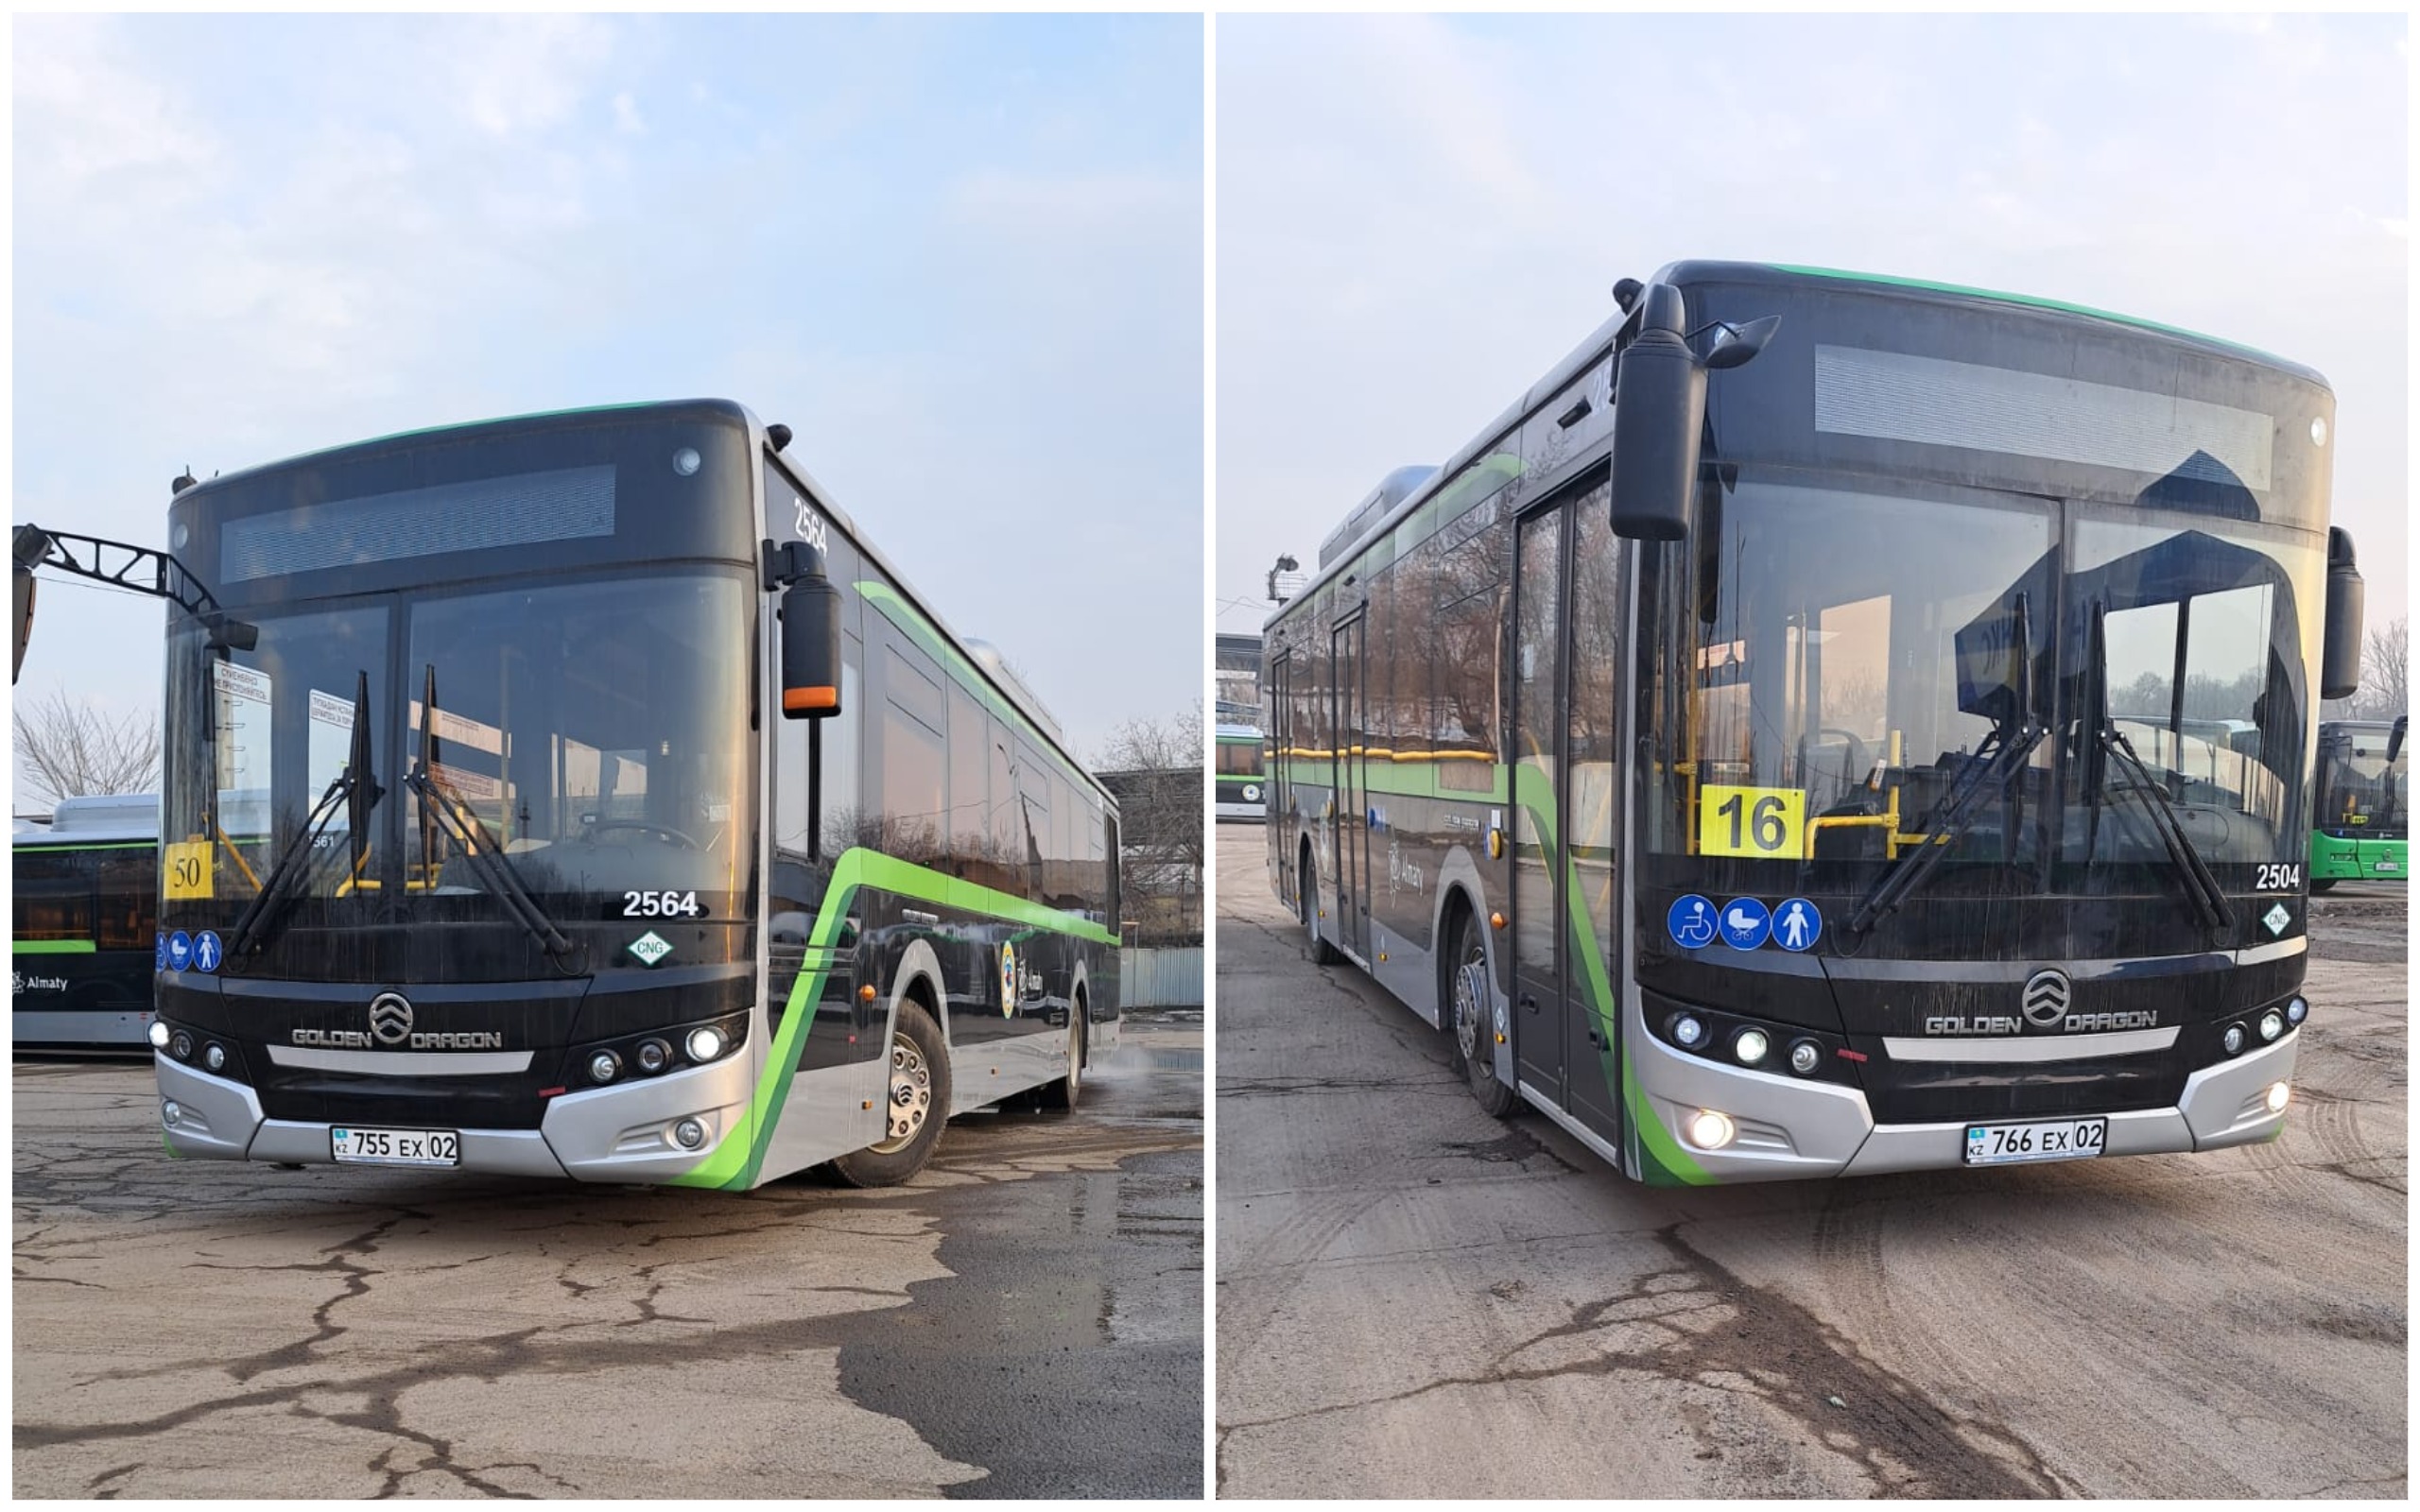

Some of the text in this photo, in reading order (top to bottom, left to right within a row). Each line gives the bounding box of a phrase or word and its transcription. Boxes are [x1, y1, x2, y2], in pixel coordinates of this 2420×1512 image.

[795, 497, 827, 559] 2564
[1718, 794, 1787, 850] 16
[174, 857, 200, 887] 50
[2256, 864, 2300, 889] 2504
[623, 890, 699, 917] 2564
[2269, 912, 2286, 925] CNG
[637, 941, 664, 954] CNG
[26, 975, 68, 992] Almaty
[1925, 1010, 2157, 1035] GOLDEN DRAGON
[292, 1028, 502, 1049] GOLDEN DRAGON
[336, 1143, 348, 1154] KZ
[354, 1132, 456, 1159] 755 EX 02
[1969, 1145, 1984, 1156] KZ
[1992, 1124, 2102, 1155] 766 EX 02
